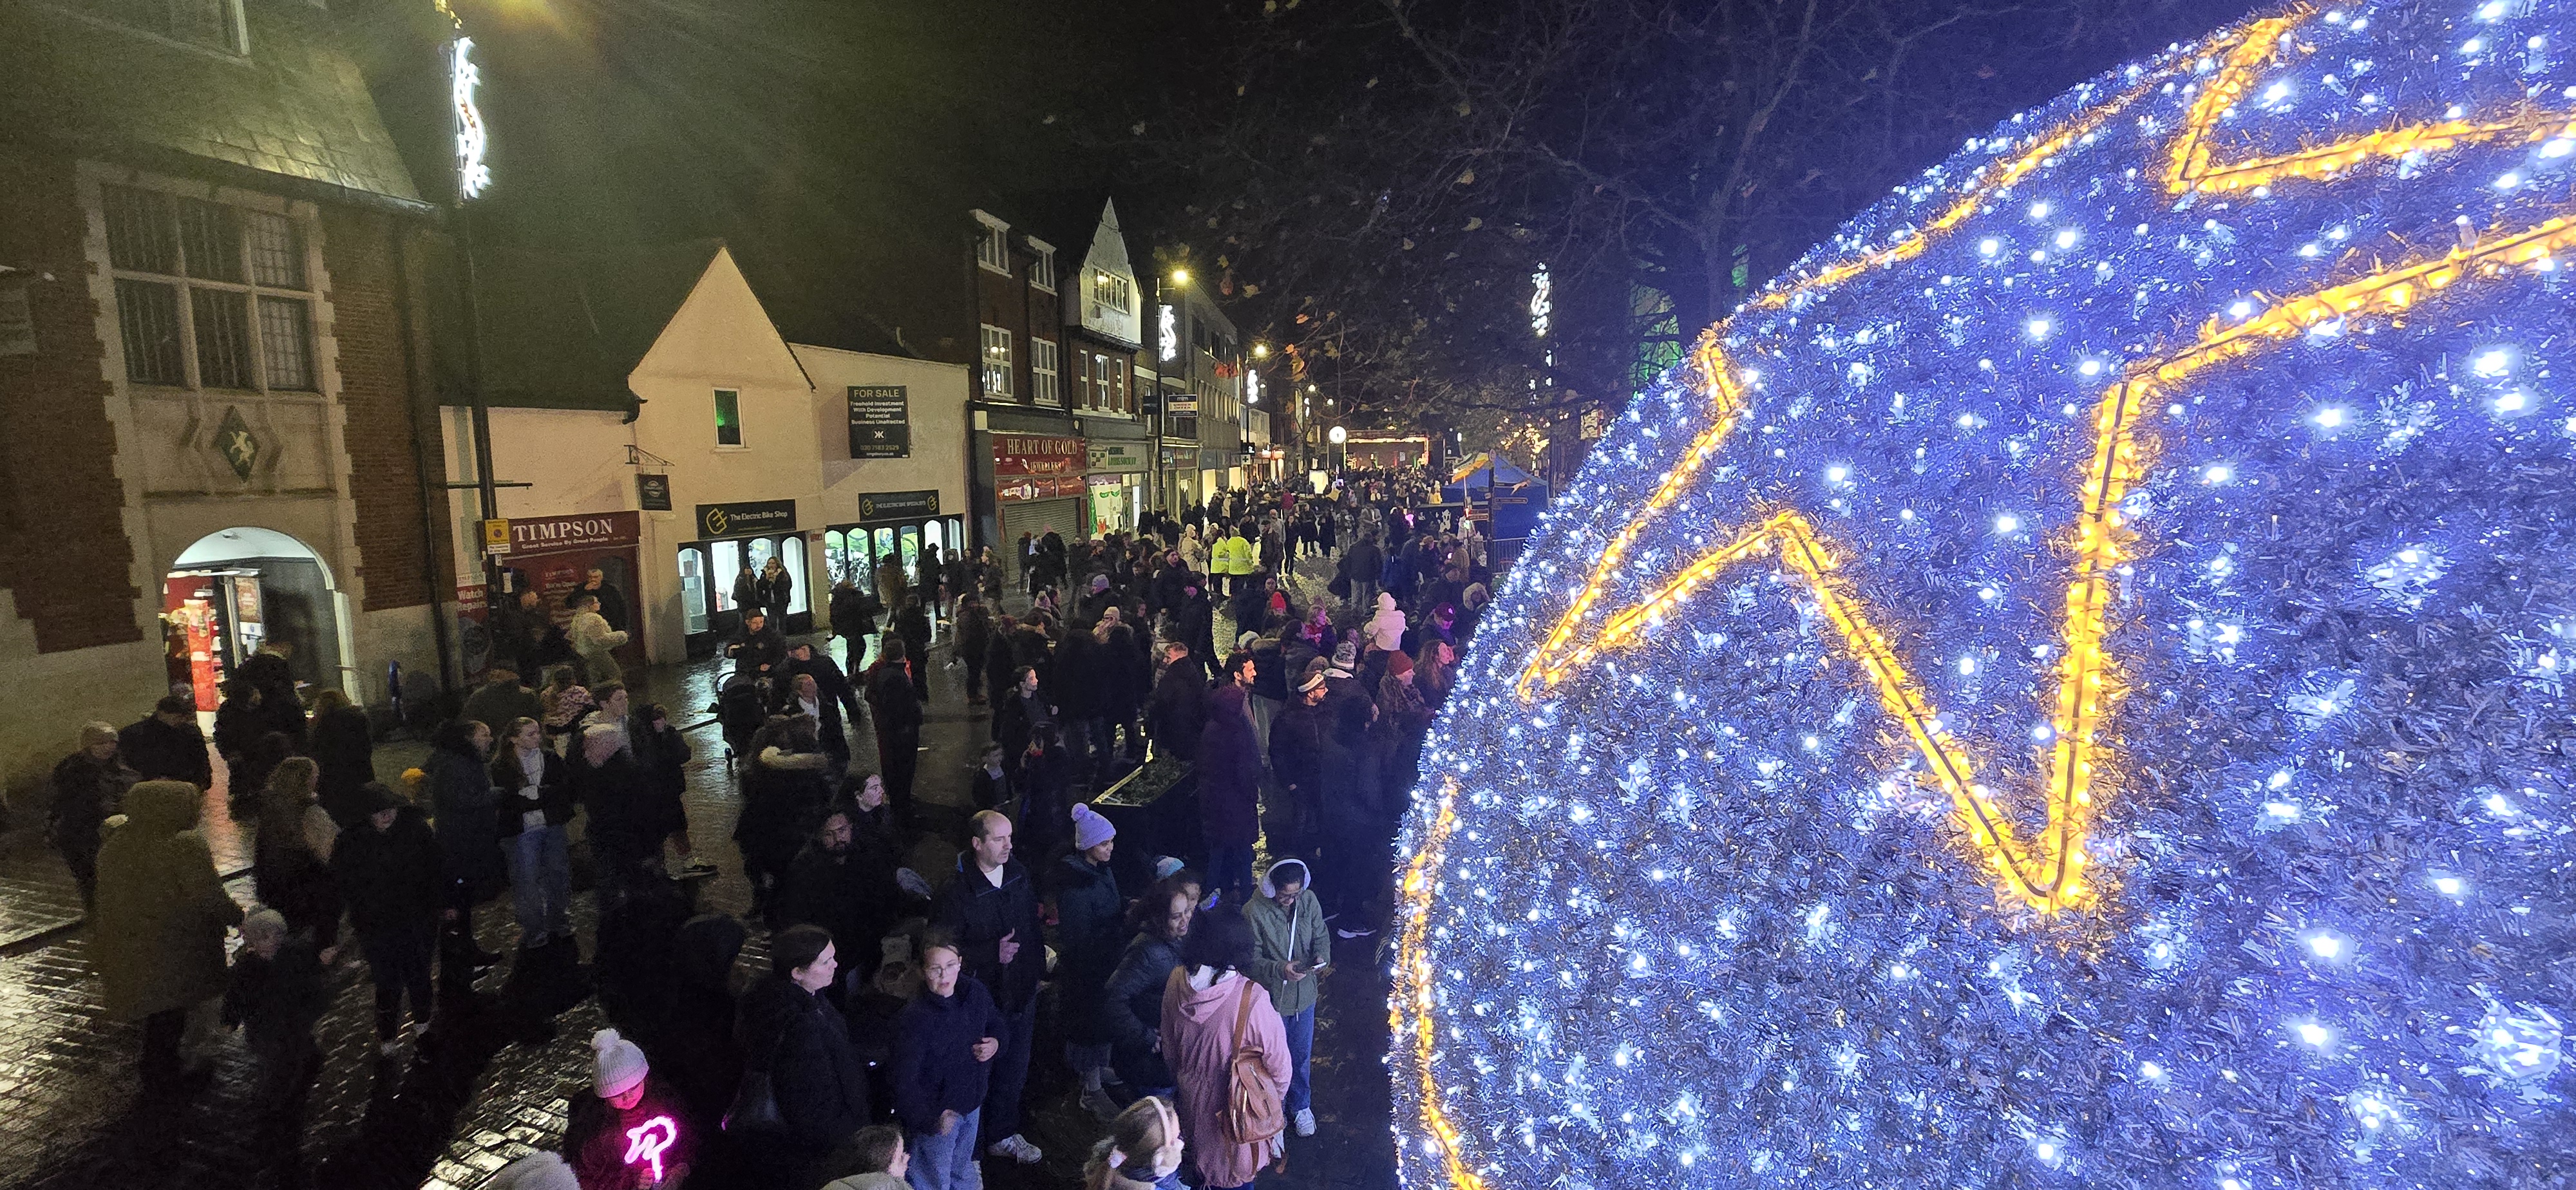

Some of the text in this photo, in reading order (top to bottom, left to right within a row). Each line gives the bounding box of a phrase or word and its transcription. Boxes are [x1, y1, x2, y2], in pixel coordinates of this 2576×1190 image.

[854, 389, 900, 398] FOR SALE
[1007, 439, 1077, 455] HEART OF GOLD
[741, 512, 761, 520] Electric
[513, 518, 612, 542] TIMPSON
[457, 588, 484, 600] Watch
[457, 600, 488, 612] Repairs
